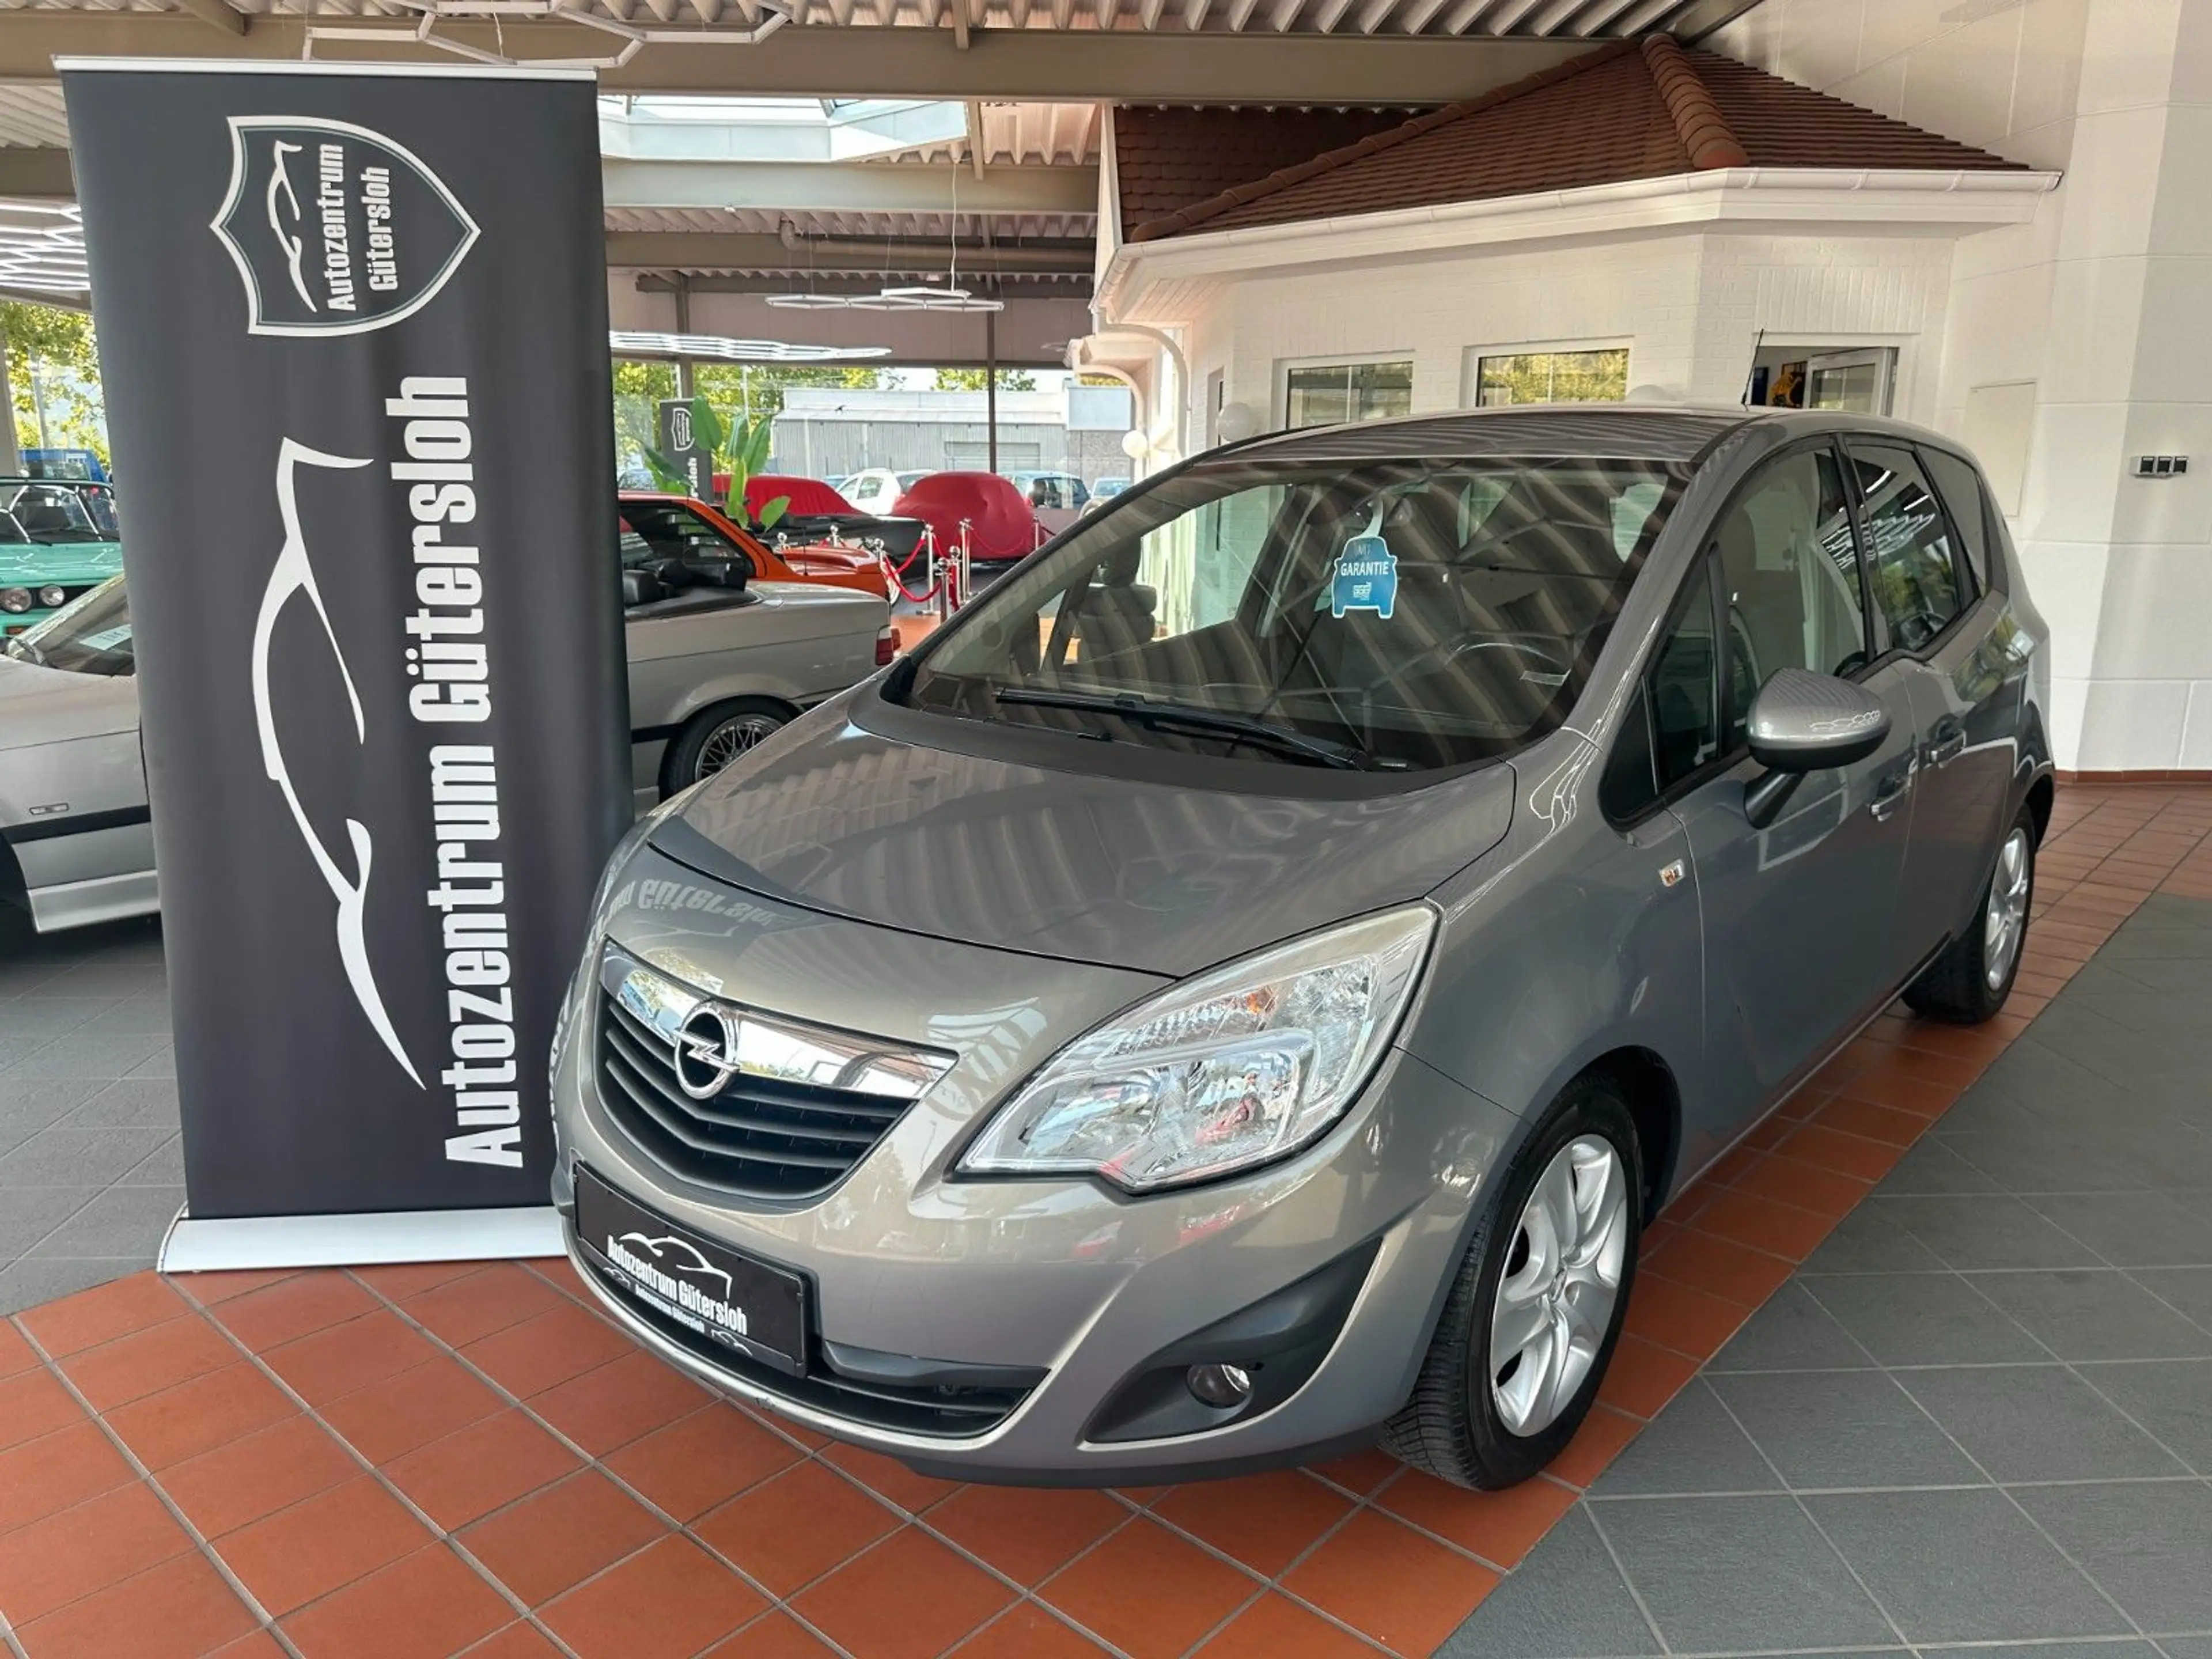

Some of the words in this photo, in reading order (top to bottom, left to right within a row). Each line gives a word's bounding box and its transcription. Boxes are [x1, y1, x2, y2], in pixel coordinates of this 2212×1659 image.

[317, 143, 357, 312] Autozentrum
[361, 166, 398, 291] Gütersloh
[385, 376, 491, 722] Gütersloh
[1340, 561, 1389, 577] GARANTIE
[427, 745, 523, 1168] Autozentrum
[608, 1234, 678, 1302] Autozentrum
[678, 1279, 748, 1335] Gütersloh
